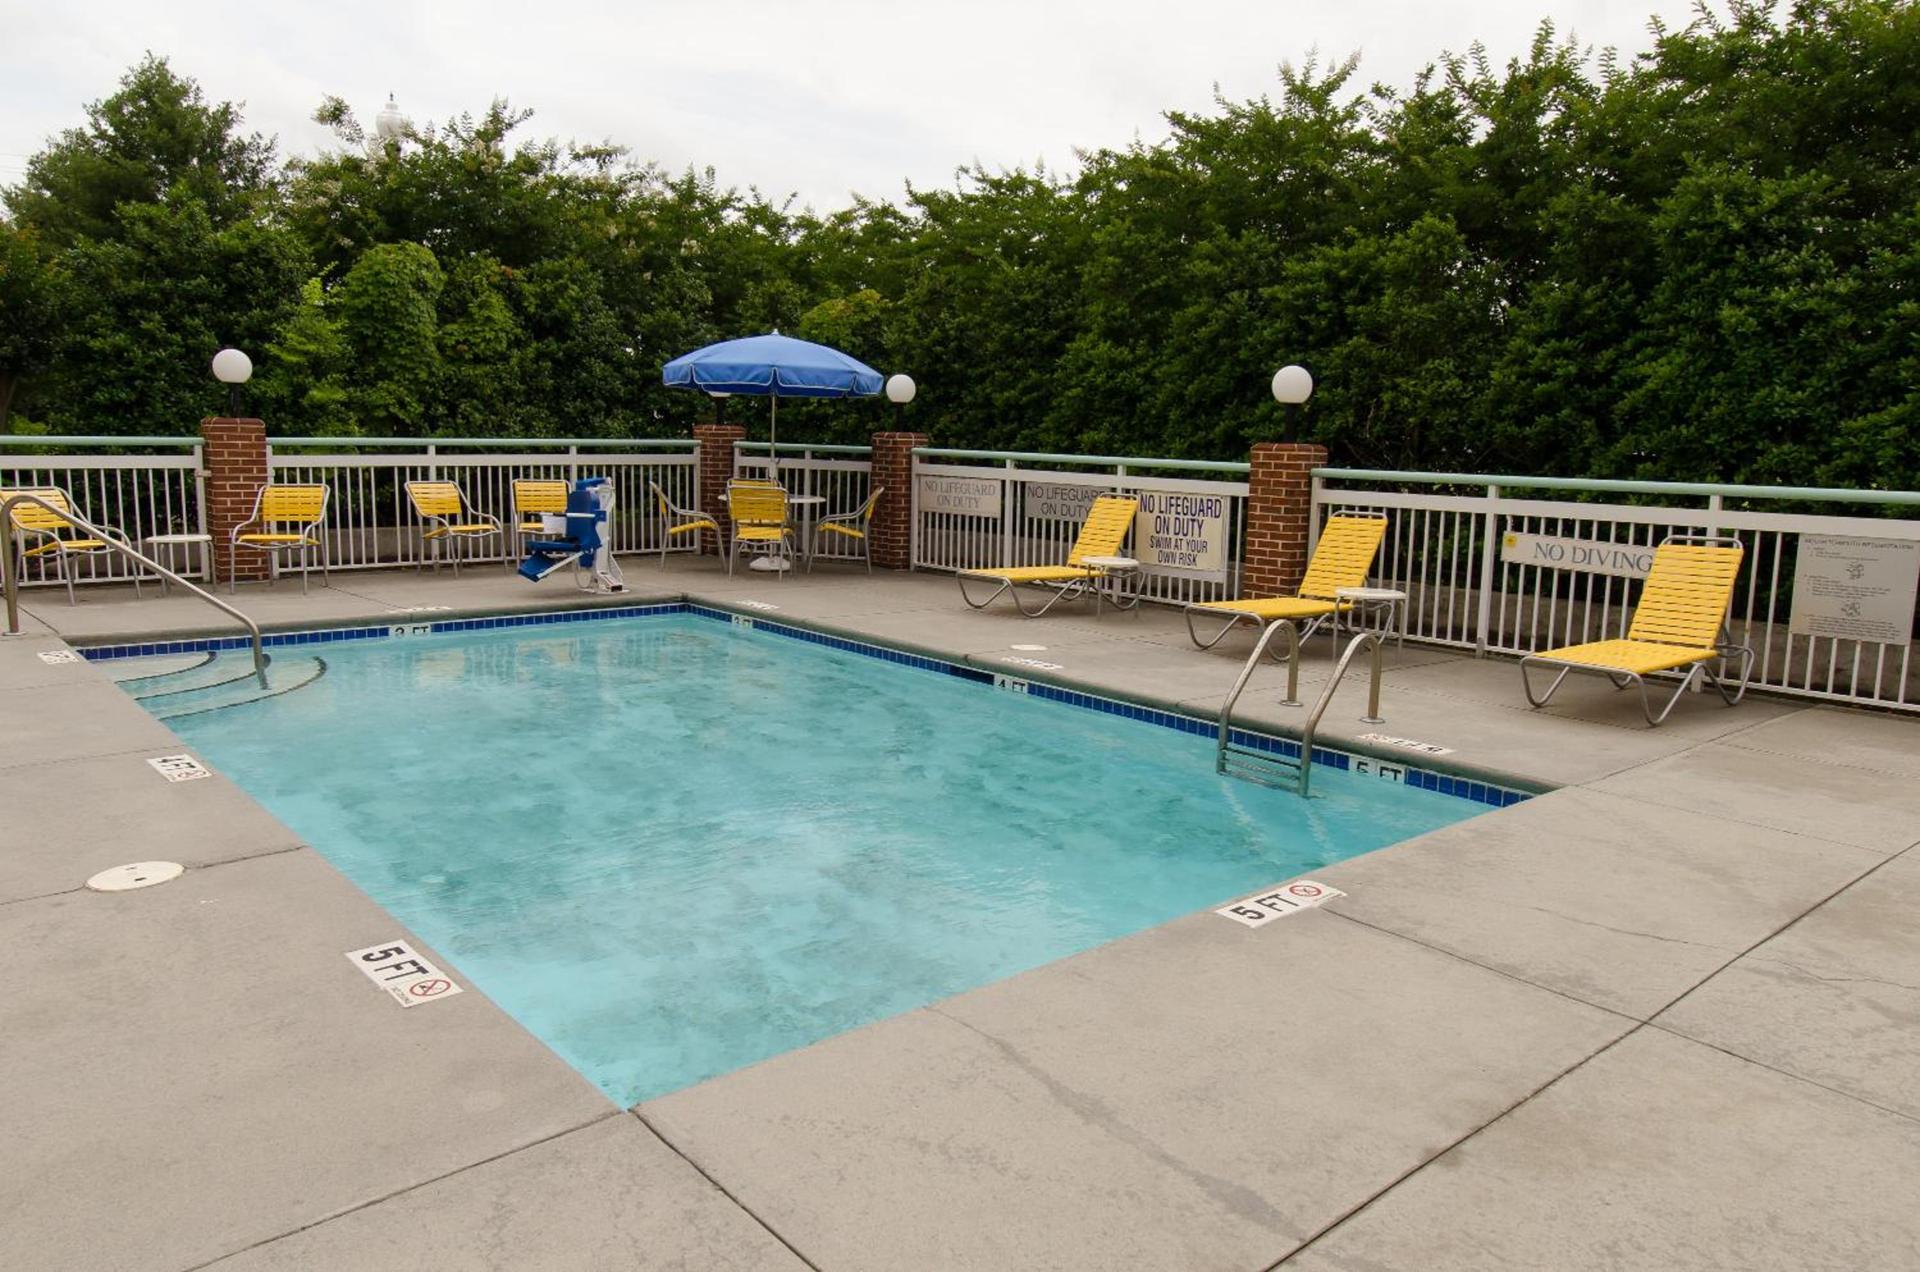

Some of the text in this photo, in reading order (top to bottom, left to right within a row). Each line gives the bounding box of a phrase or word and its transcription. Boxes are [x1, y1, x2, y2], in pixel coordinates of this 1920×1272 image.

[925, 480, 996, 496] NO LIFEGUARD
[1027, 486, 1105, 502] NO LIFEGUAR
[937, 495, 979, 508] ON DUTY
[1041, 502, 1057, 515] ON
[1140, 494, 1222, 519] NO LIFEGUARD
[1155, 515, 1204, 538] ON DUTY
[1150, 535, 1208, 553] SWIM AT YOUR
[1158, 550, 1198, 567] OWN RISK
[1533, 542, 1653, 573] NO DIVING
[1356, 761, 1403, 782] 5 FT
[1228, 905, 1266, 921] 5
[1254, 893, 1299, 913] FT
[361, 946, 430, 981] 5 FT
